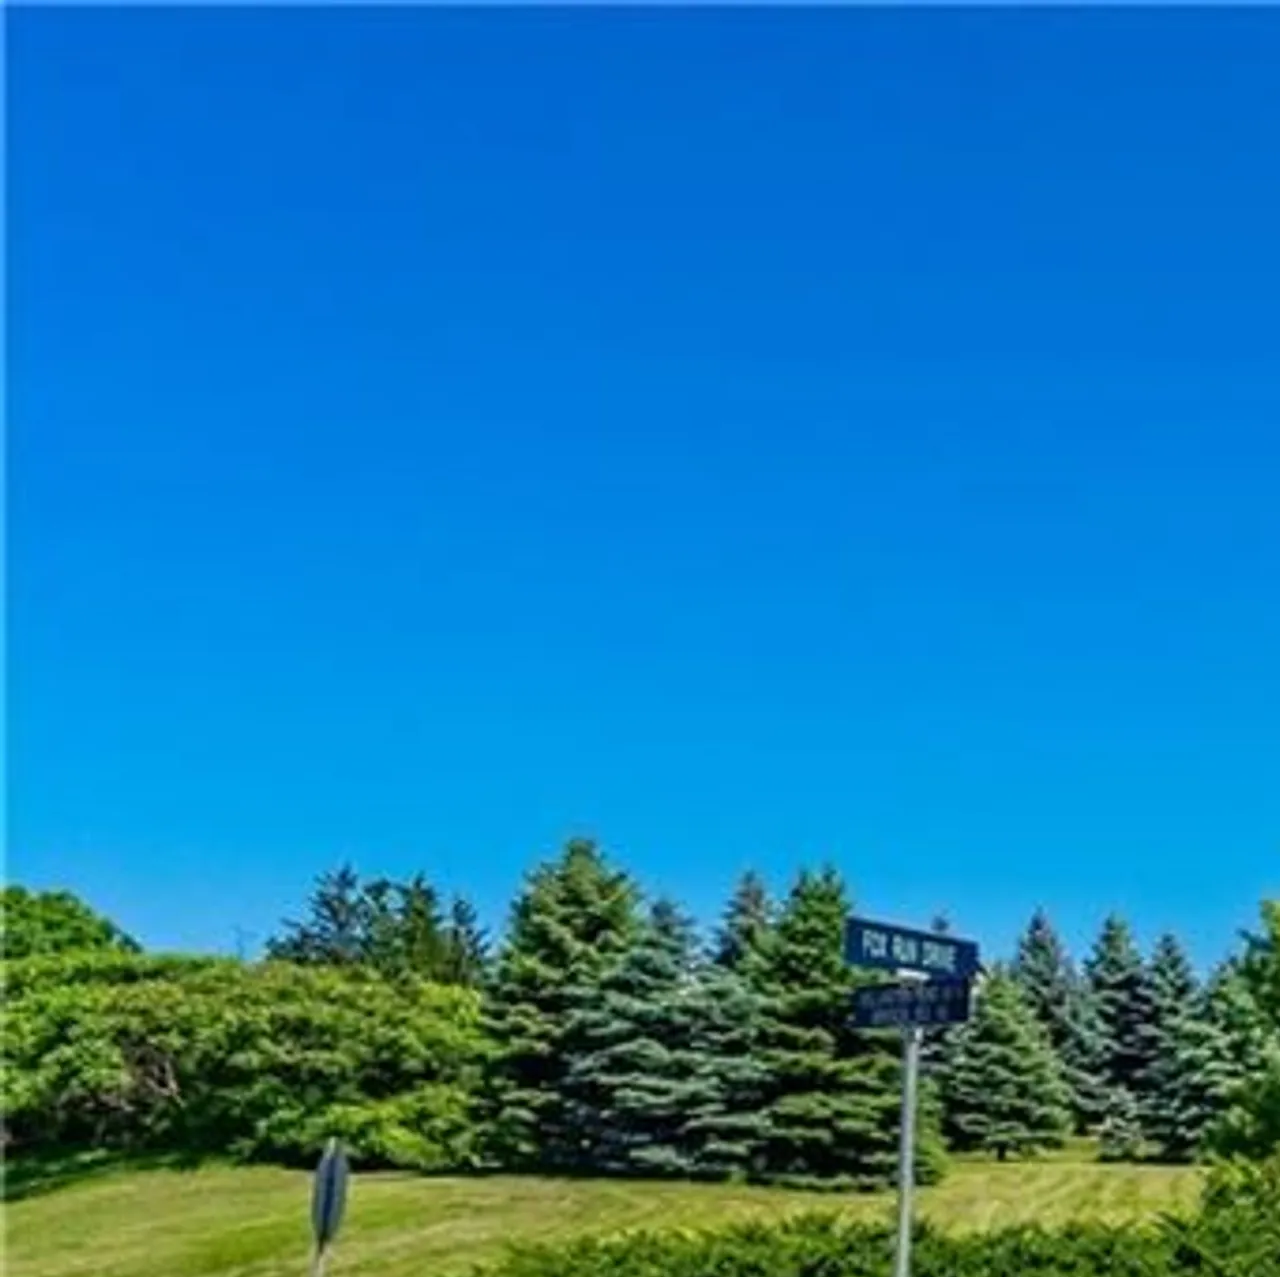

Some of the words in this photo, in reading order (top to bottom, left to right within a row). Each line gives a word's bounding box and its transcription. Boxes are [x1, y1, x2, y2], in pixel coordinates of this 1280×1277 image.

[861, 929, 887, 958] FOX
[892, 935, 918, 964] RUN
[922, 940, 957, 973] DRIVE
